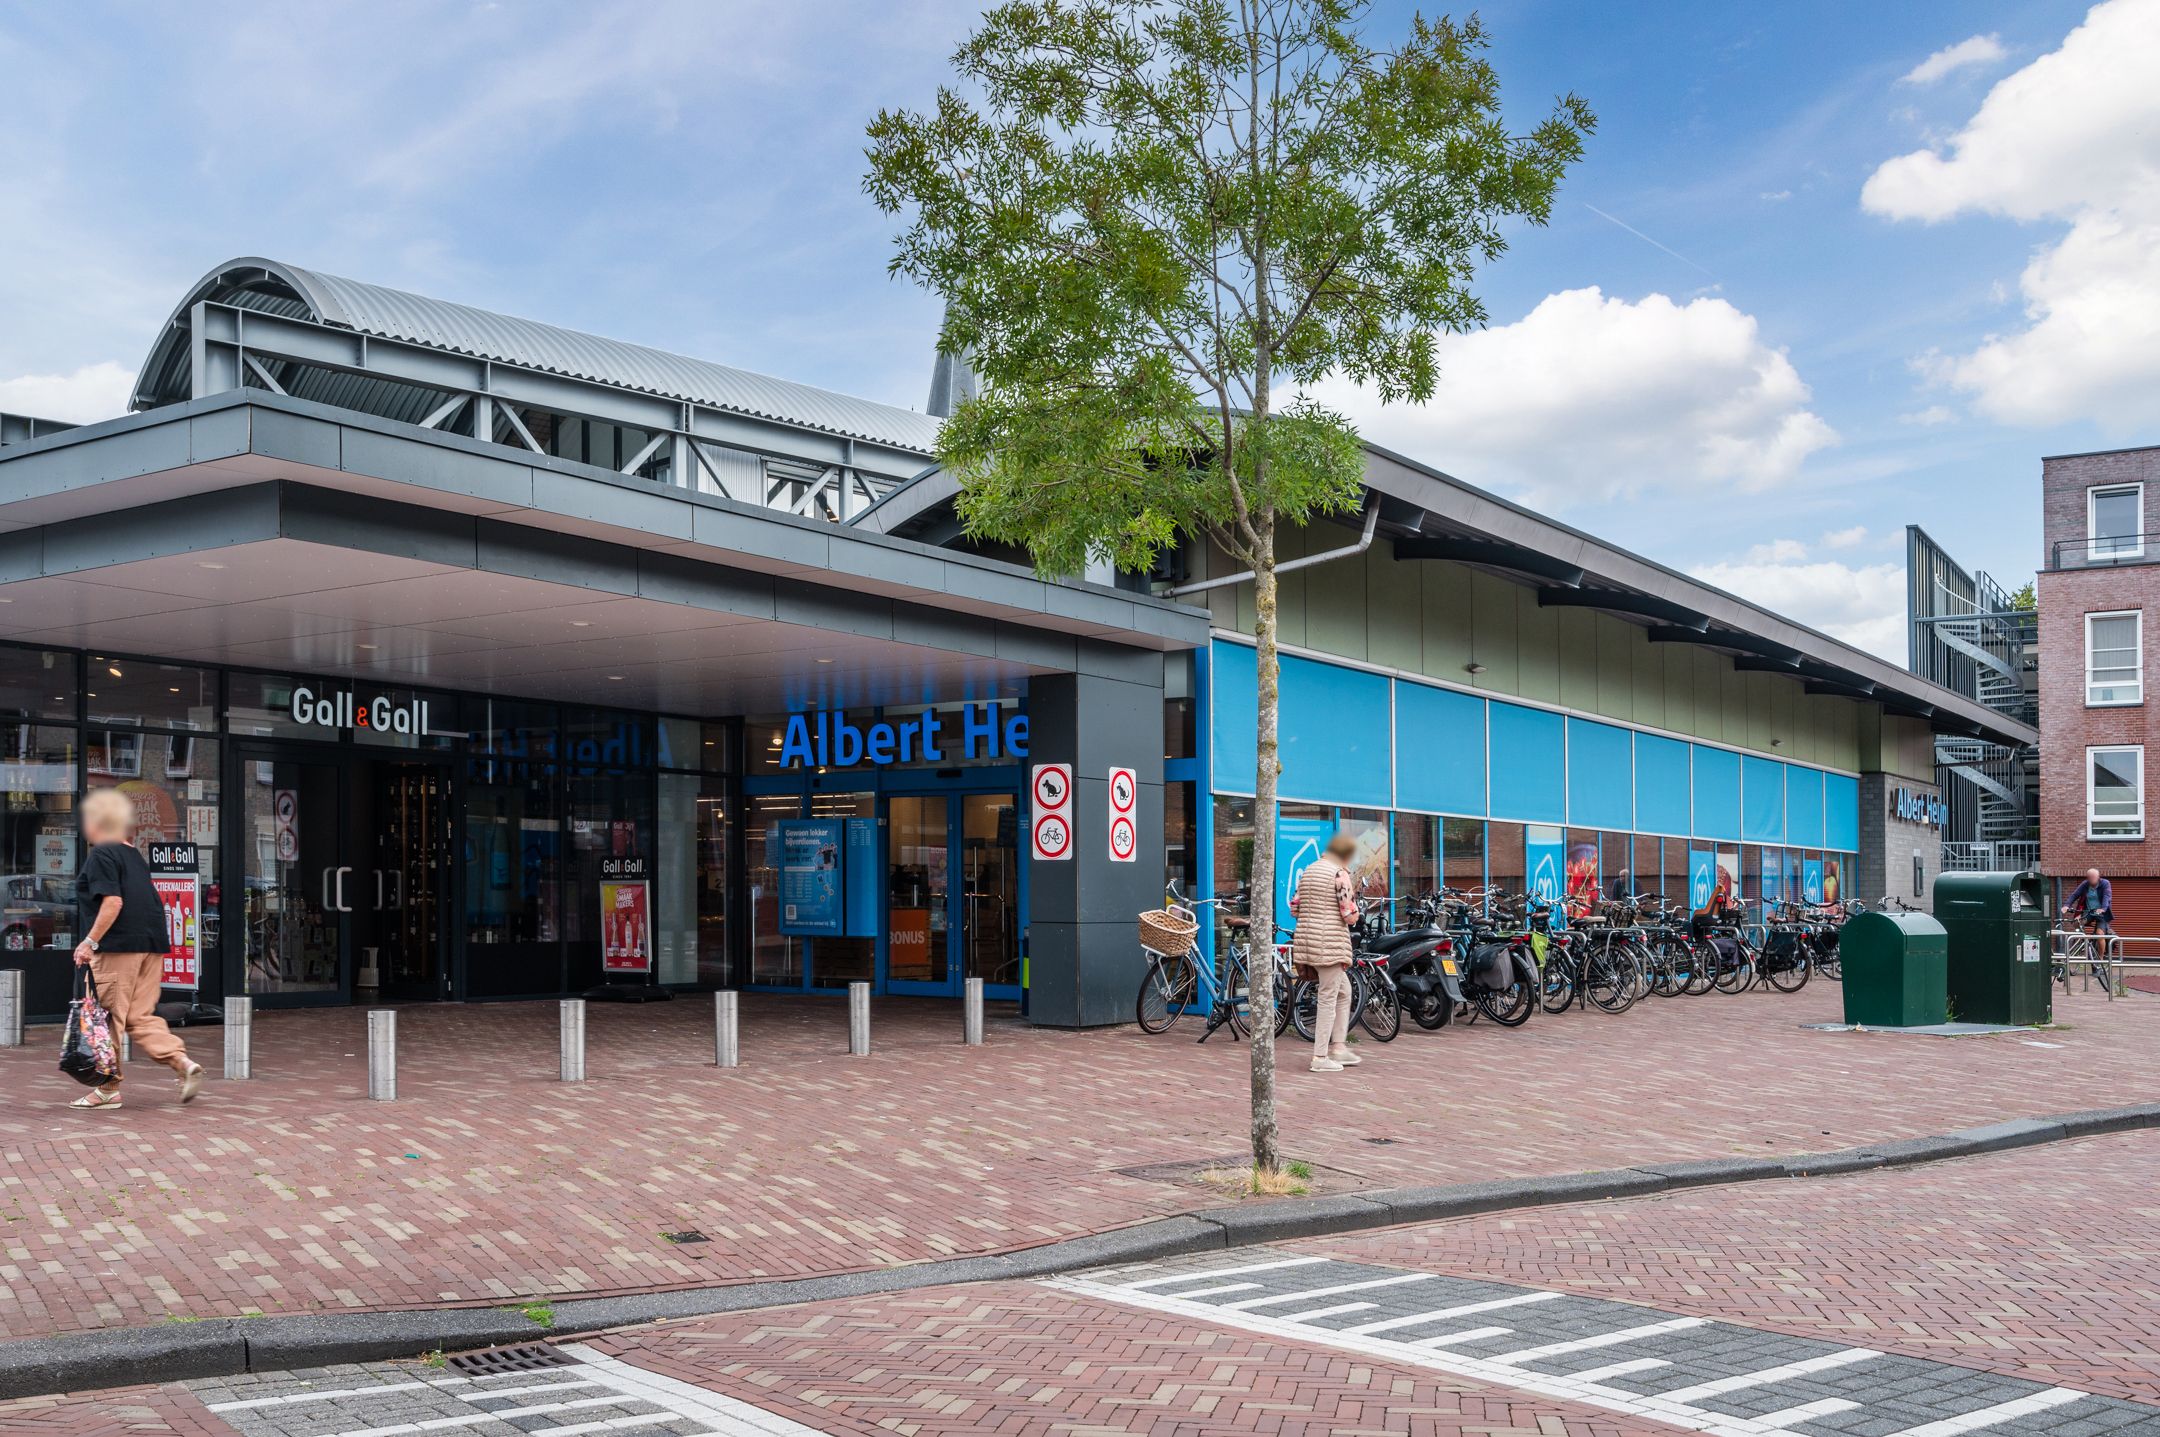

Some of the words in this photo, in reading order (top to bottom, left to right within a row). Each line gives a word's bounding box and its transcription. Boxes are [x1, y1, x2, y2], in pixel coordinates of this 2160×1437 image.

[779, 707, 944, 769] Albert
[1897, 786, 1925, 821] Albert
[889, 930, 926, 945] BONUS
